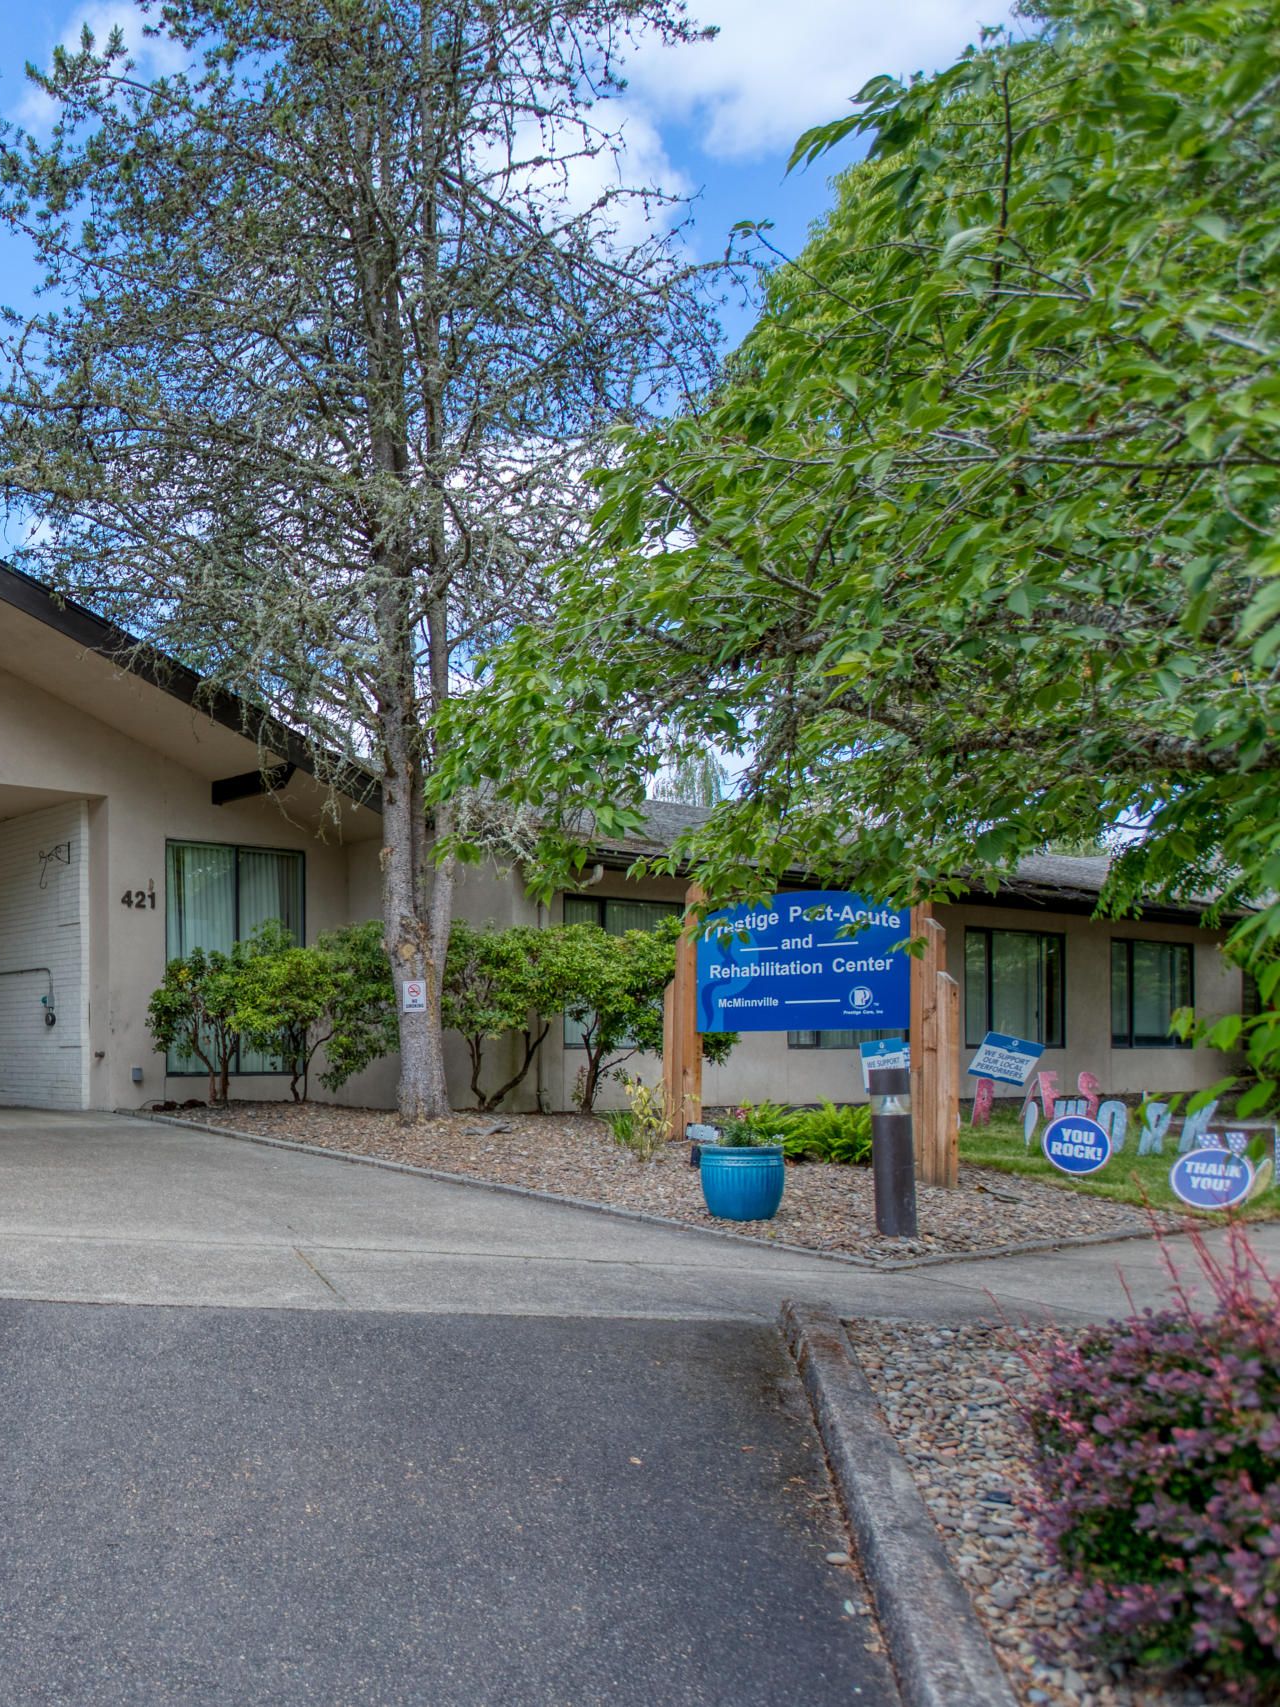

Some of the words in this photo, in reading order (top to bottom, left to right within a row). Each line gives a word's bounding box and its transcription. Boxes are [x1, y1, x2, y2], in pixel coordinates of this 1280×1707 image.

[121, 890, 156, 910] 421
[781, 934, 813, 950] and
[710, 960, 823, 979] Rehabilitation
[832, 957, 894, 973] Center
[718, 997, 779, 1008] McMinnville
[1061, 1128, 1095, 1145] YOU
[1050, 1142, 1103, 1161] ROCK!
[1185, 1161, 1242, 1178] THANK
[1190, 1176, 1232, 1192] YOU!
